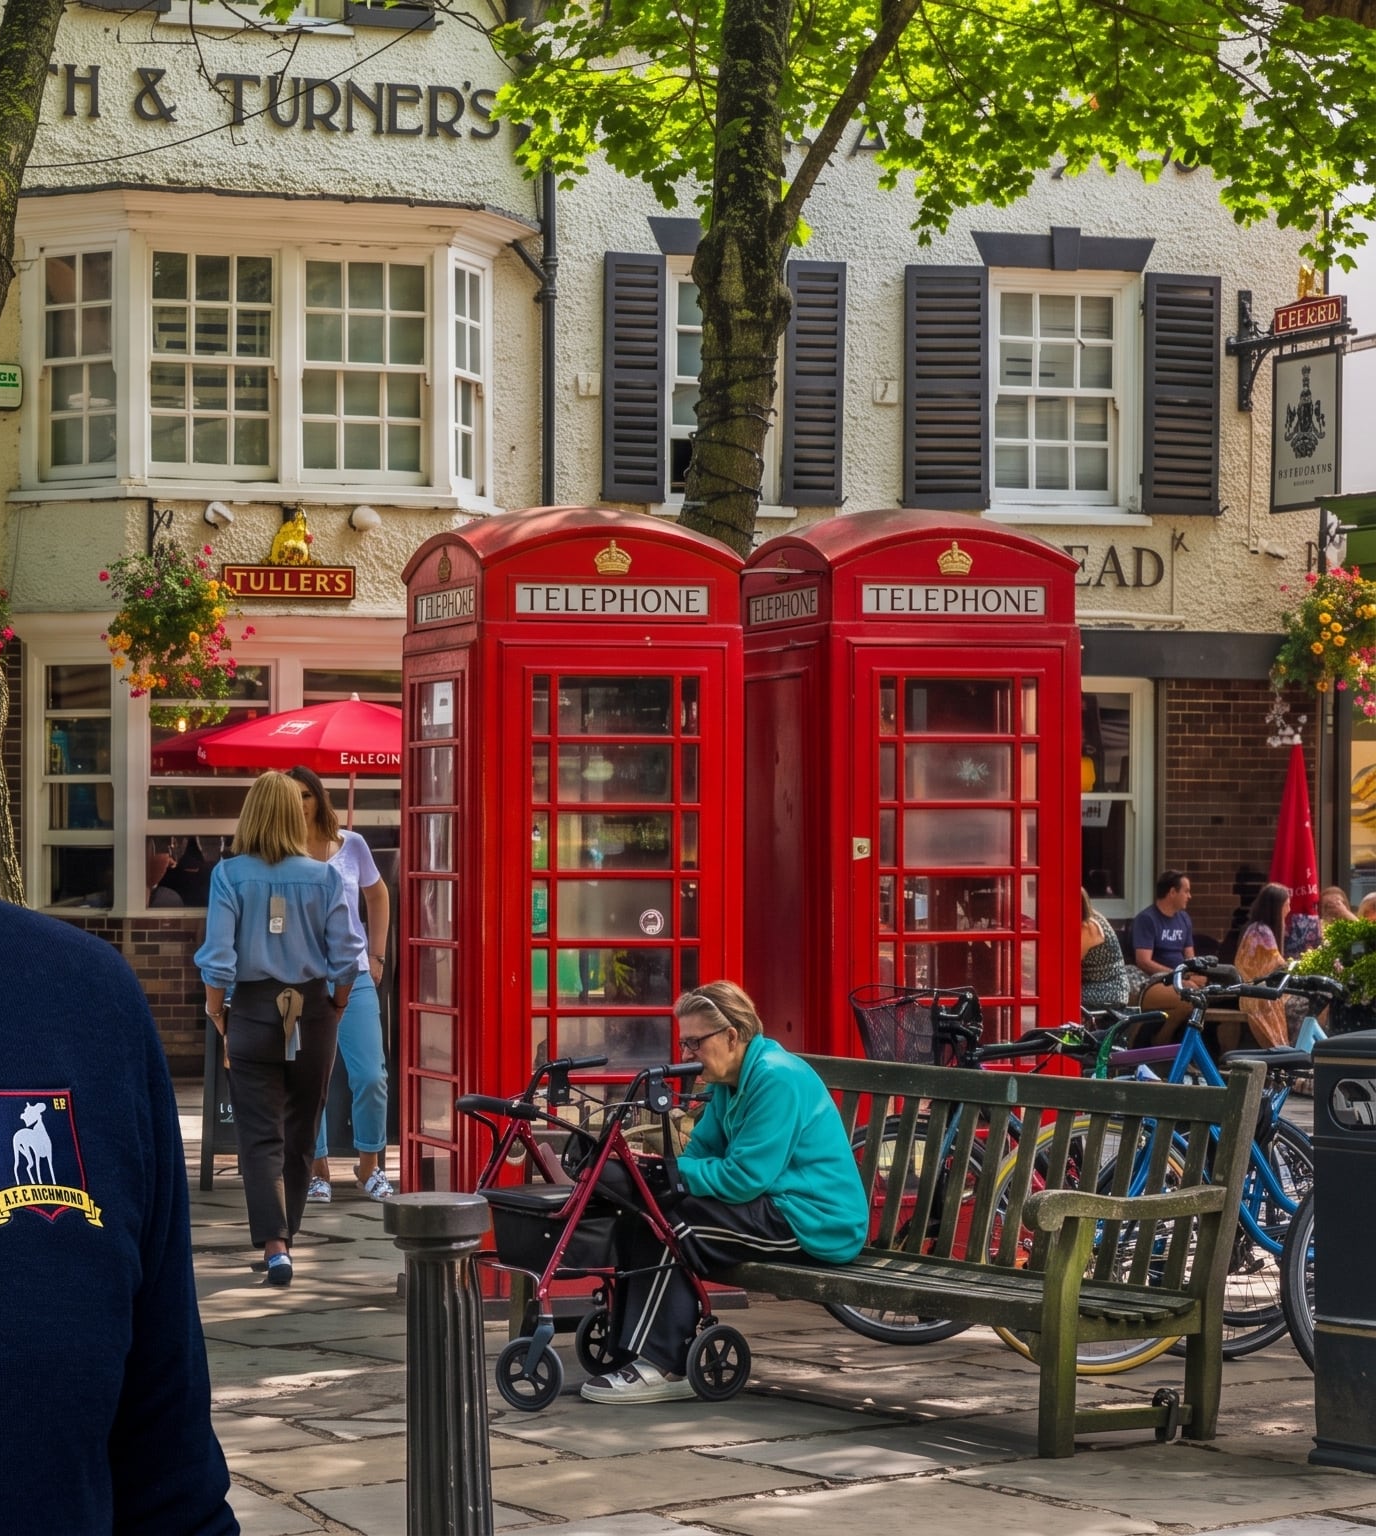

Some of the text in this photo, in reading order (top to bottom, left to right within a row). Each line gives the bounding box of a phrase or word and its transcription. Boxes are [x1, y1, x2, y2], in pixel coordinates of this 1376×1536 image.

[134, 66, 178, 122] &
[215, 72, 500, 139] TURNER'S
[232, 572, 346, 592] TULLER'S
[523, 586, 701, 613] TELEPHONE
[868, 587, 1038, 613] TELEPHONE
